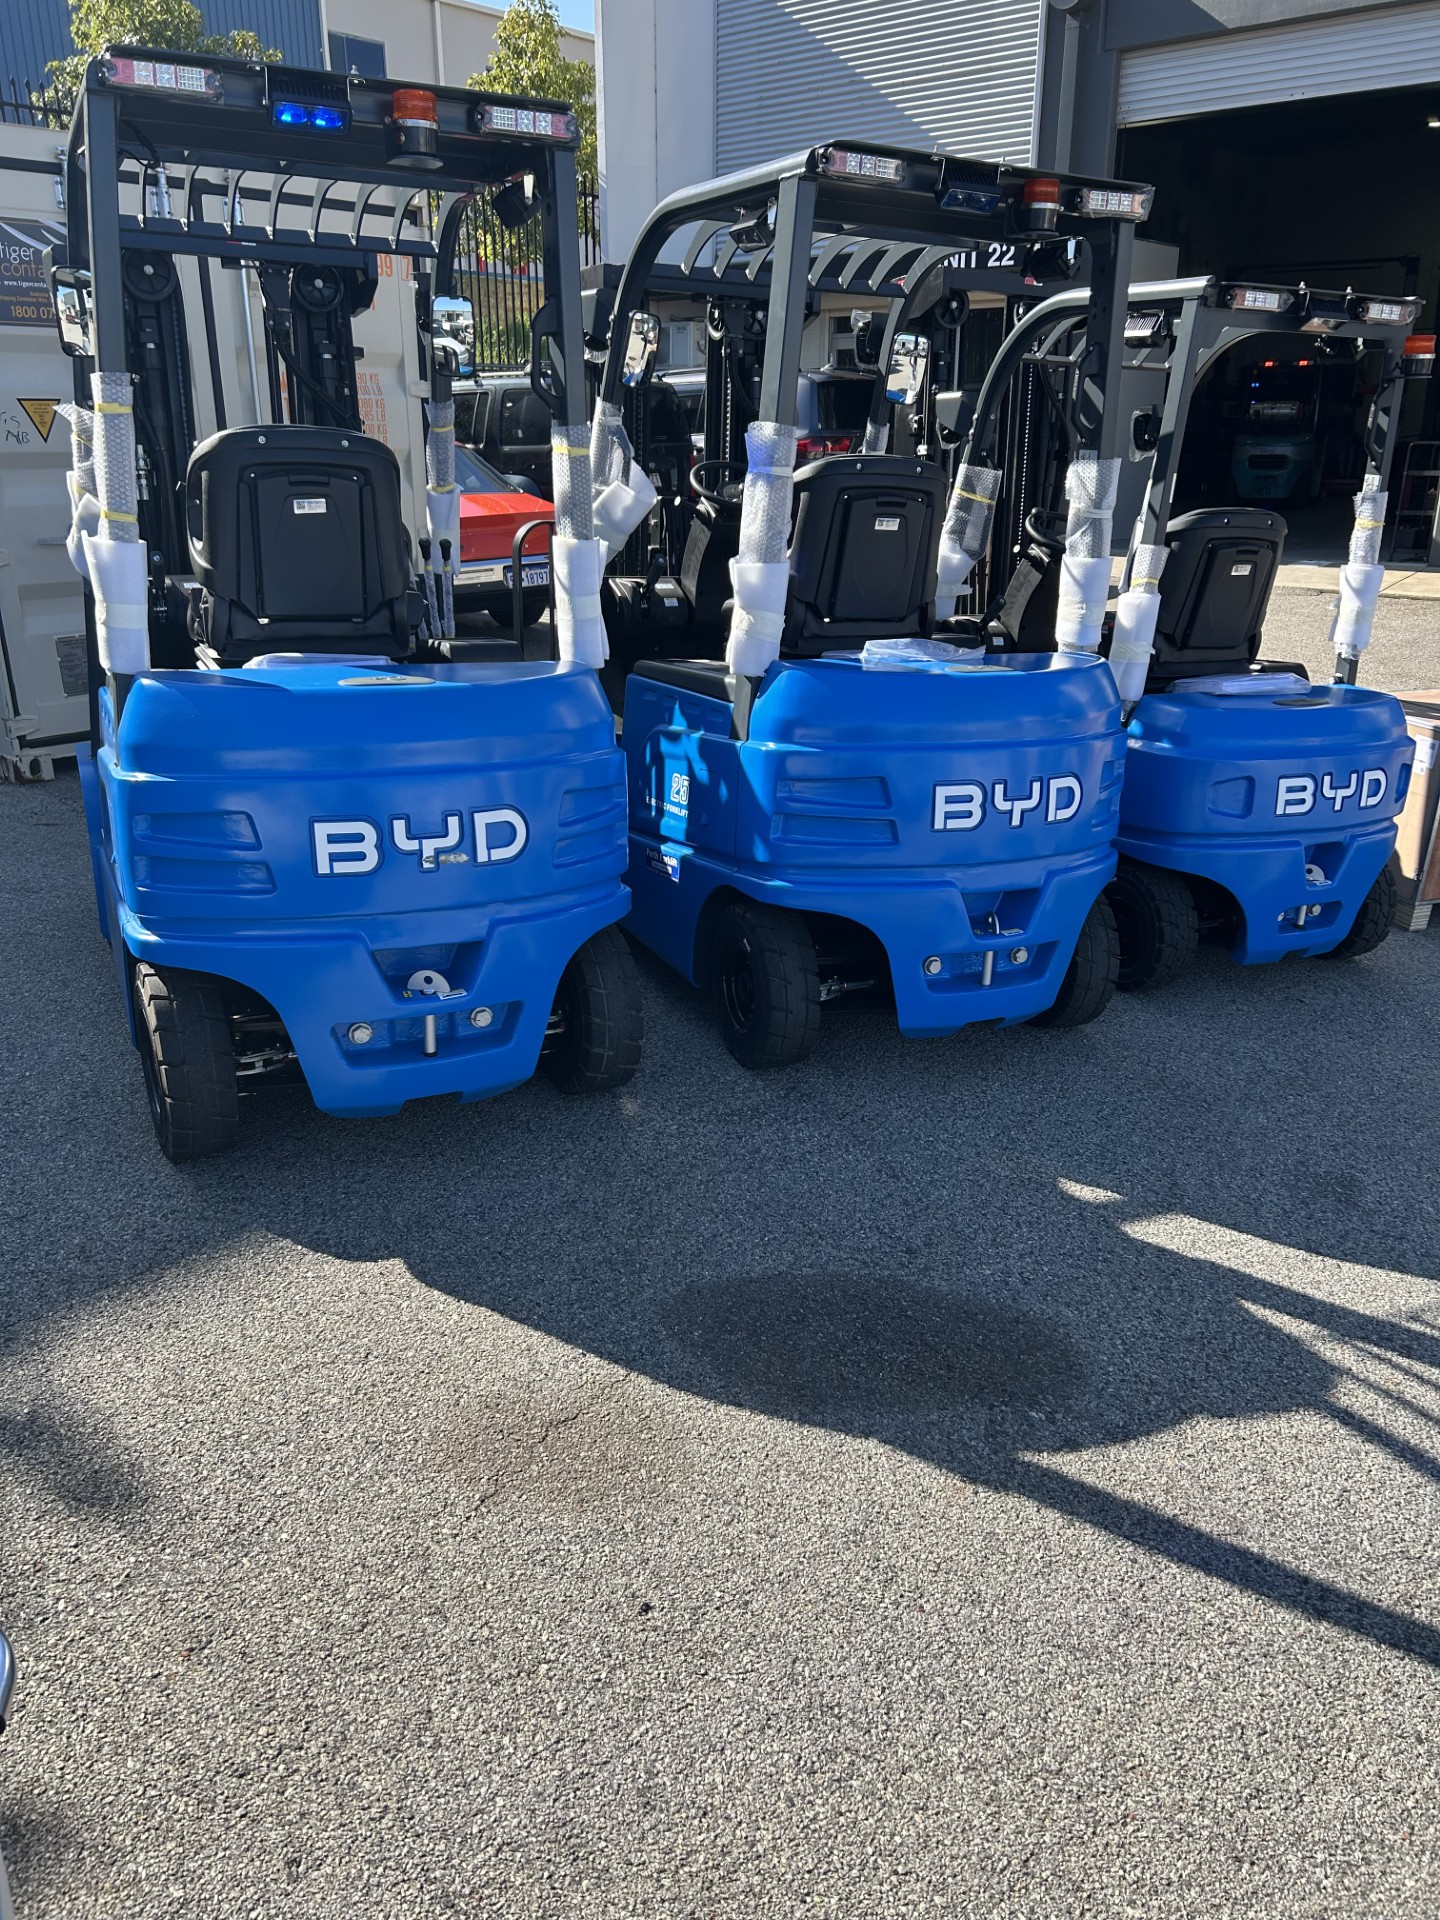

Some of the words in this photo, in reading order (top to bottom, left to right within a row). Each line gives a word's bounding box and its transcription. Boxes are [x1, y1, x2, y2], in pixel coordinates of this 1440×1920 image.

[0, 242, 35, 263] tiger
[938, 251, 977, 268] NIT
[987, 243, 1015, 267] 22
[11, 306, 37, 318] 1800
[40, 307, 56, 319] 07
[370, 374, 379, 384] KG
[372, 385, 382, 395] LB
[376, 398, 385, 409] KG
[376, 410, 386, 421] LB
[363, 423, 375, 435] 00
[671, 772, 690, 805] 25
[1275, 769, 1387, 815] BYD
[666, 803, 689, 818] FORKLIFT
[933, 776, 1081, 830] BYD
[313, 808, 527, 875] BYD
